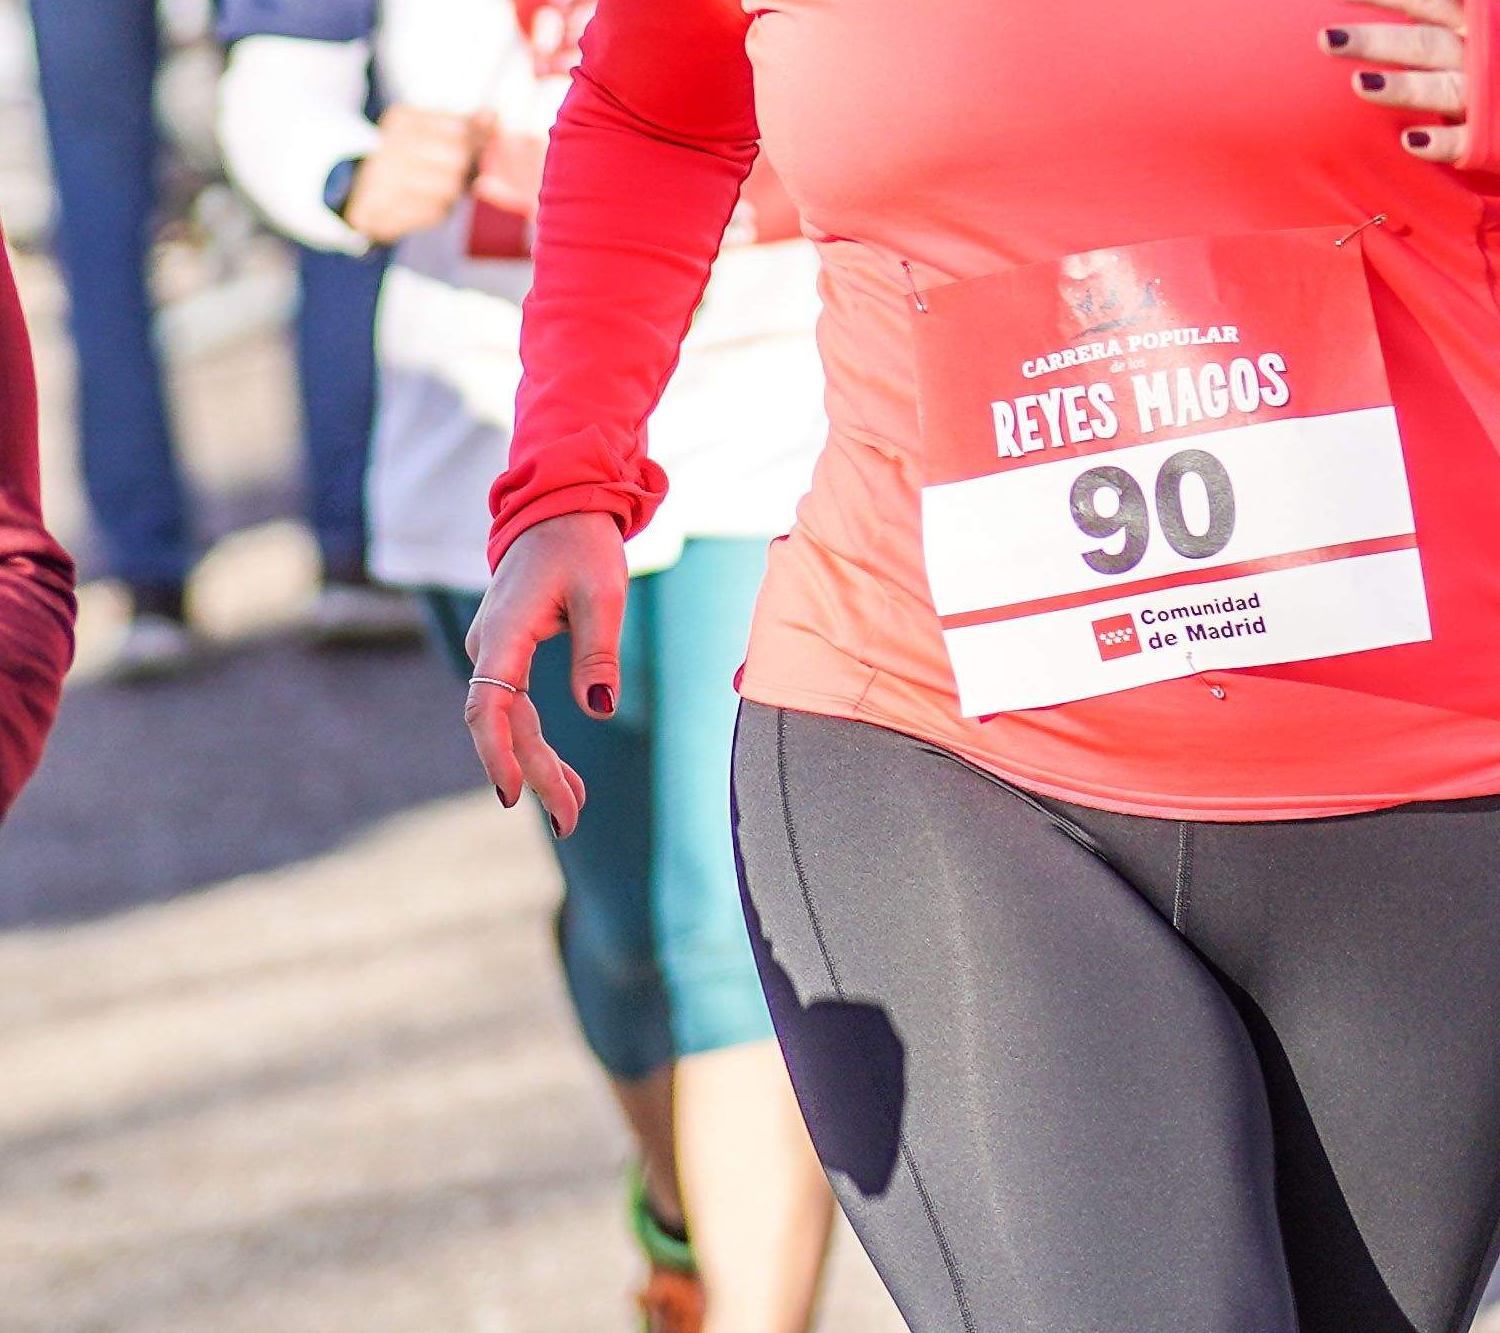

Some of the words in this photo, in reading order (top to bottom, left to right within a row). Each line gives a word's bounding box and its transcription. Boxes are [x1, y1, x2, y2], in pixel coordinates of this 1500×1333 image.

[1021, 339, 1123, 379] CARRERA
[1128, 325, 1240, 353] POPULAR
[990, 382, 1119, 458] REYES
[1131, 352, 1290, 434] MAGOS
[1070, 449, 1236, 575] 90
[1140, 592, 1261, 625] Comunidad
[1148, 632, 1178, 650] de
[1185, 616, 1267, 642] Madrid
